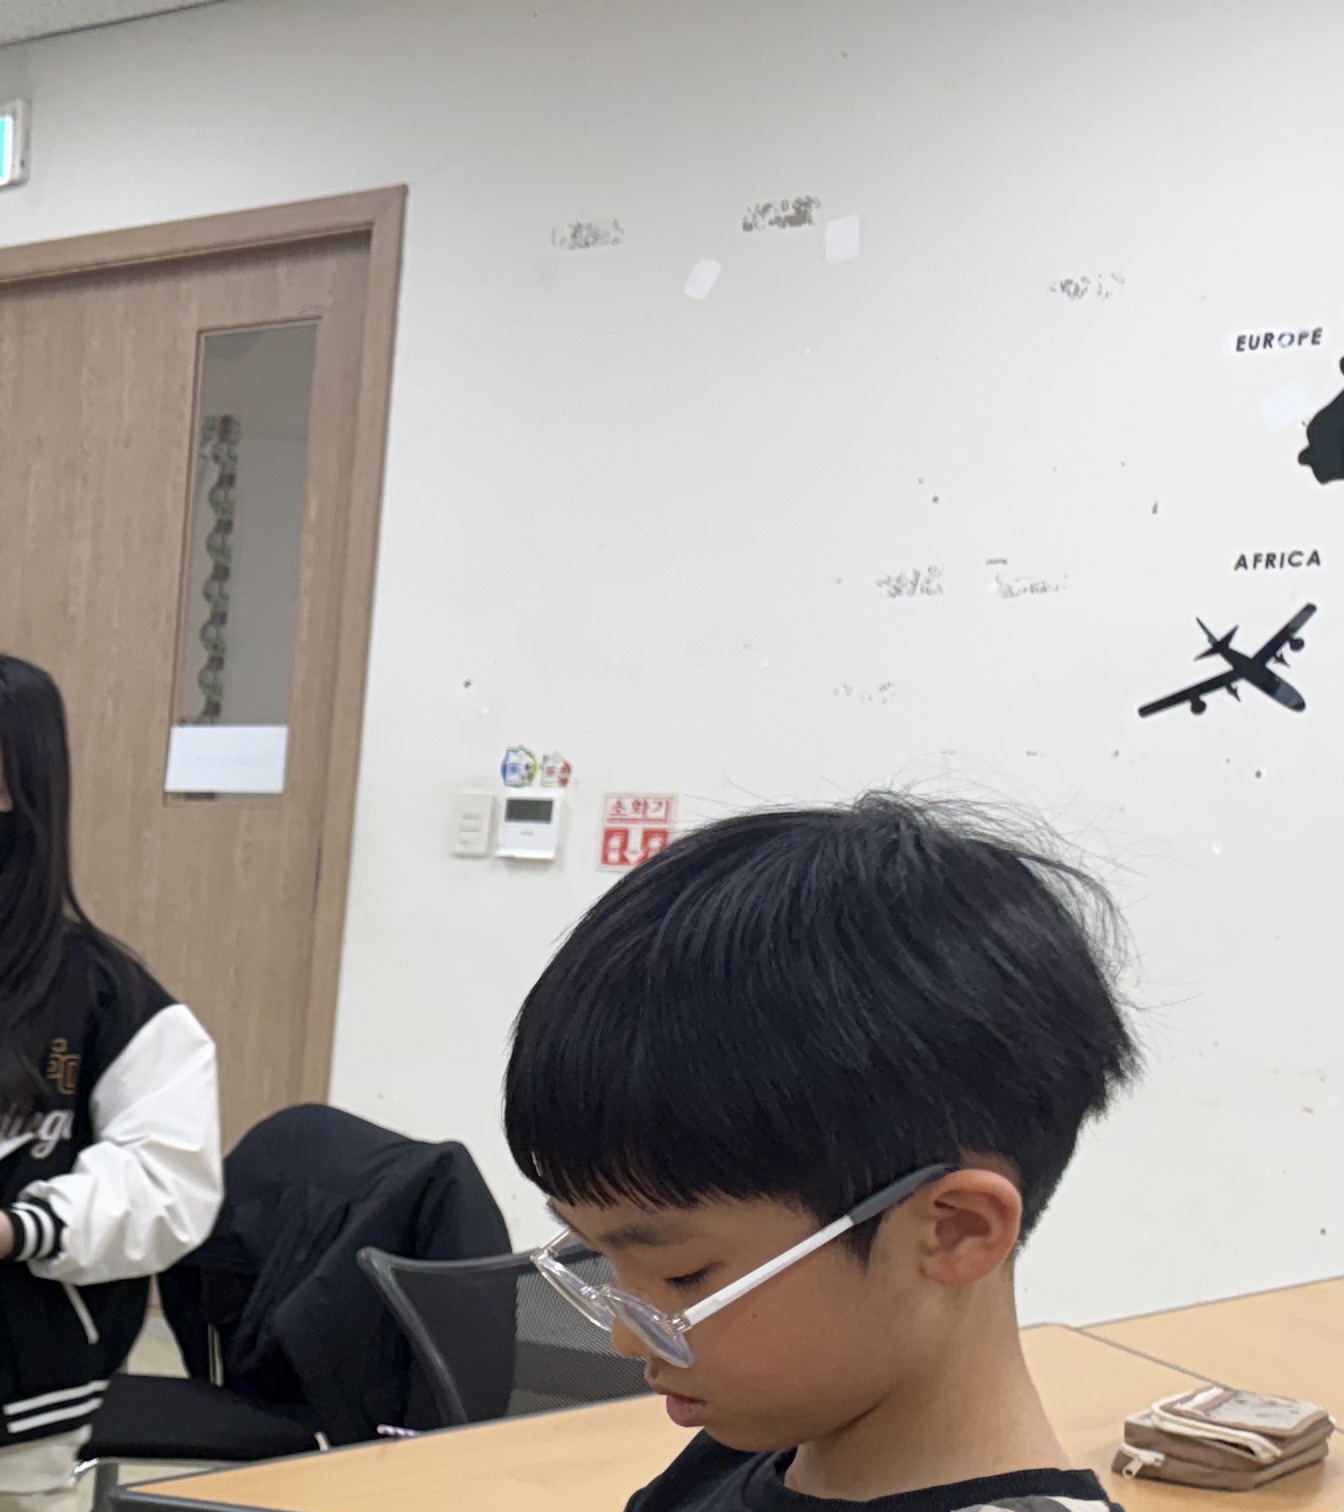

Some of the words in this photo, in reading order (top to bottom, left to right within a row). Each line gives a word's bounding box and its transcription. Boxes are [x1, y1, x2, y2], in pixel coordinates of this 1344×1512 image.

[1236, 327, 1322, 352] EUROPE
[1234, 548, 1321, 571] AFRICA
[608, 798, 670, 819] 소화기
